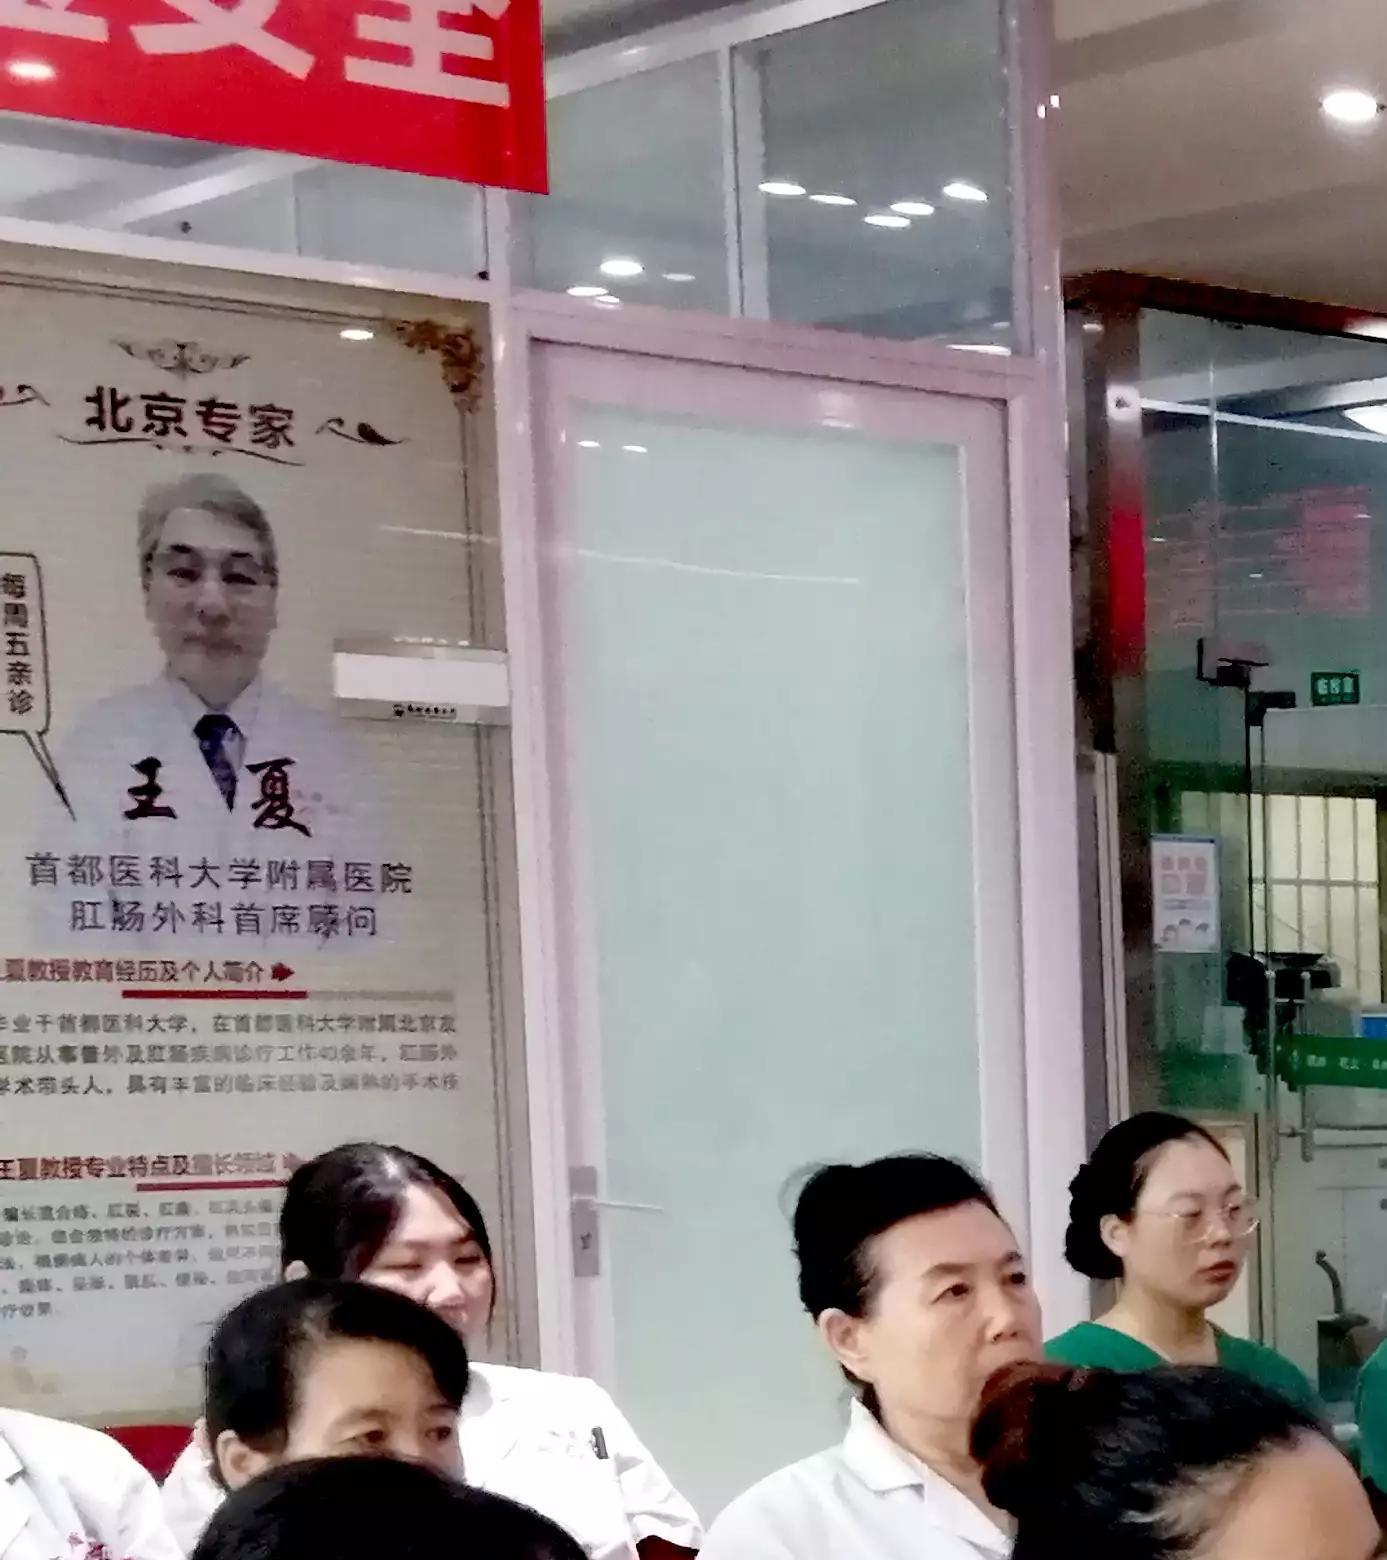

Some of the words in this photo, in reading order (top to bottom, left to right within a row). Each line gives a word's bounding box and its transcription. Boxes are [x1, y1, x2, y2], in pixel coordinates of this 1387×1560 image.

[84, 386, 296, 450] 北京专家
[26, 850, 414, 897] 首都医科大学附属医院
[69, 900, 379, 939] 肛肠外科首席顾问
[0, 958, 265, 984] 夏教授教育经历及个人简介
